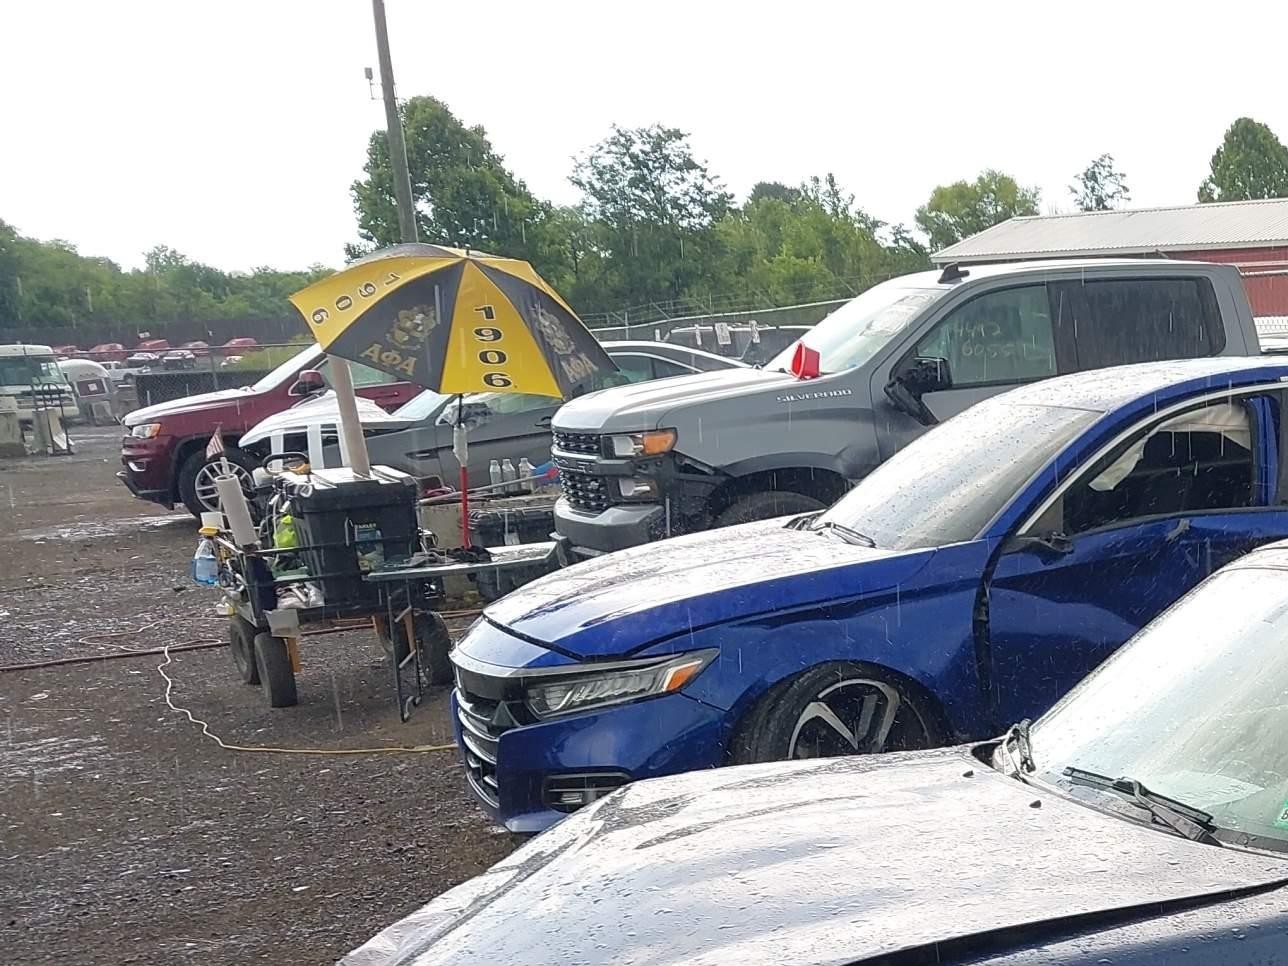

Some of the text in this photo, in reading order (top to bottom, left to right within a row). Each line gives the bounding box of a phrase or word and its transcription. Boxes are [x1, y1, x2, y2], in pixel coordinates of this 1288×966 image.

[311, 272, 401, 325] 1906
[473, 304, 513, 388] 1906
[776, 389, 854, 403] SILVERADO
